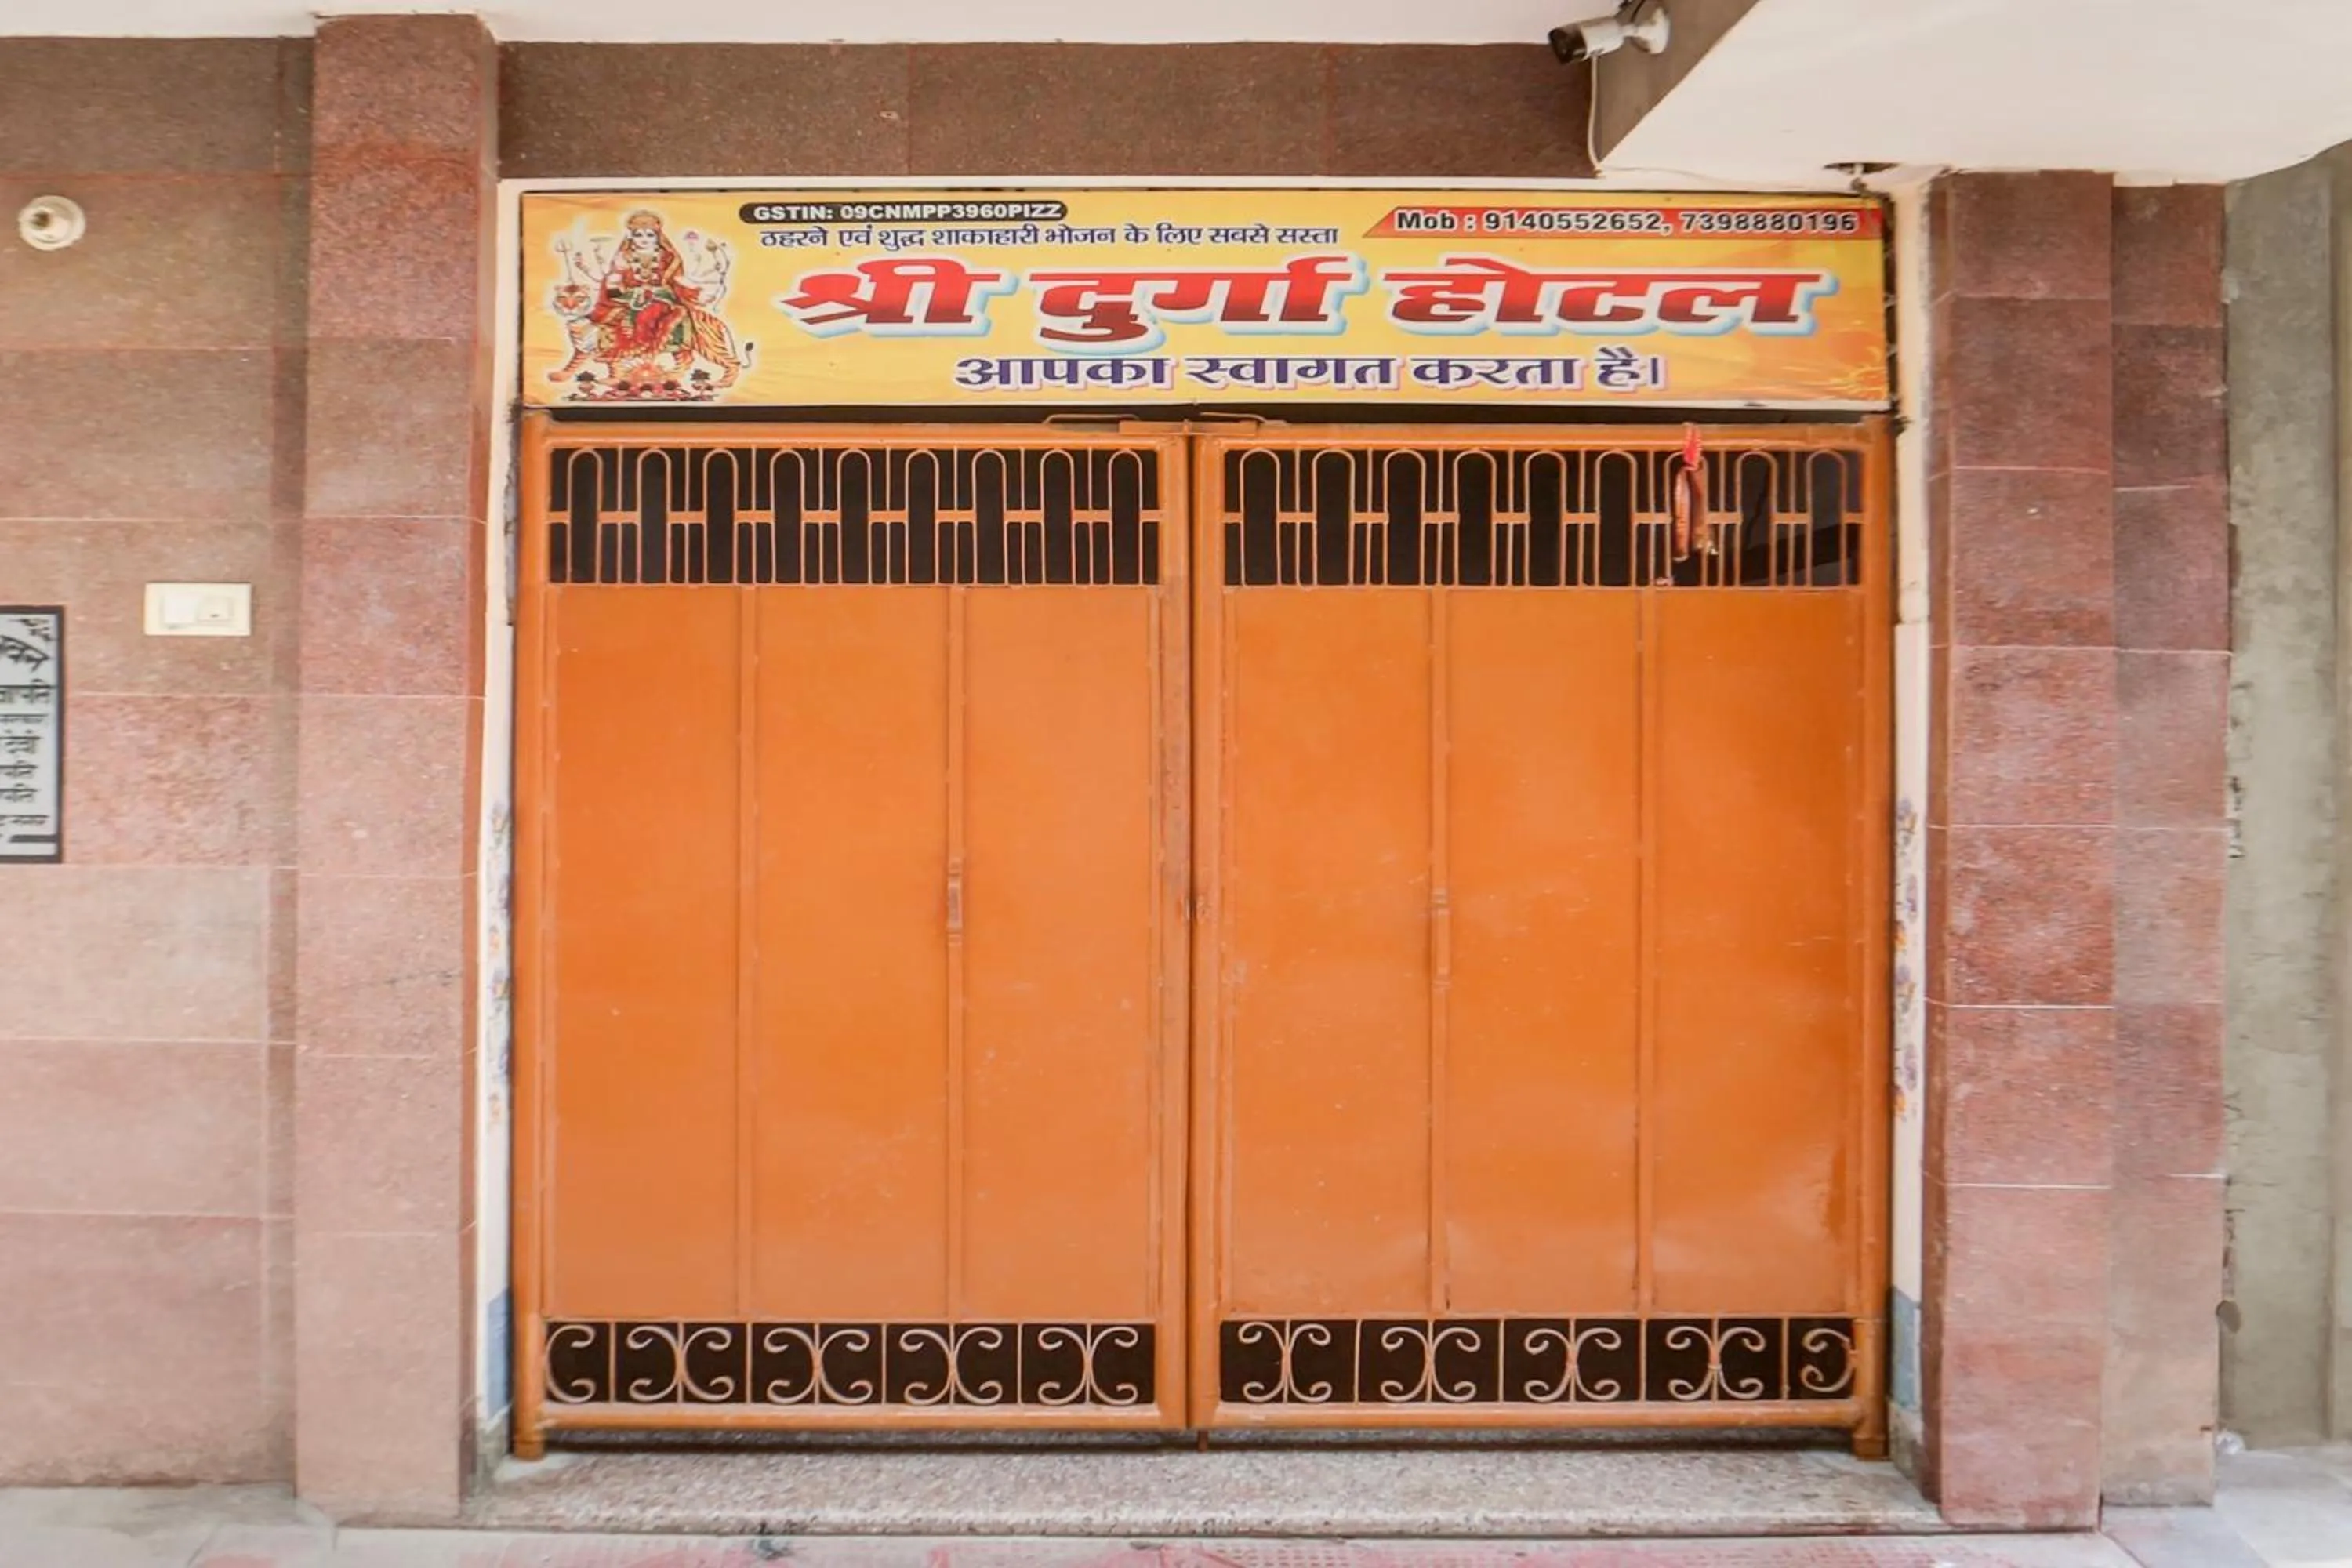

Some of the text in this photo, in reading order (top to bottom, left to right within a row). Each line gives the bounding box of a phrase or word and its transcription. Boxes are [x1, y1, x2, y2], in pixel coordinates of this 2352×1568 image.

[753, 205, 833, 220] GSTIN:
[1396, 211, 1455, 231] Mob
[1483, 212, 1671, 234] 9140552652,
[1682, 212, 1857, 233] 7398880196
[760, 223, 1339, 252] ठहरने एवं शुद्ध शाकाहारी भोजन के लिए सबसे सस्ता
[781, 256, 1820, 343] श्री दुर्गा होटल
[955, 357, 1170, 386] आपका
[1185, 357, 1396, 386] स्वागत
[1410, 357, 1581, 386] करता
